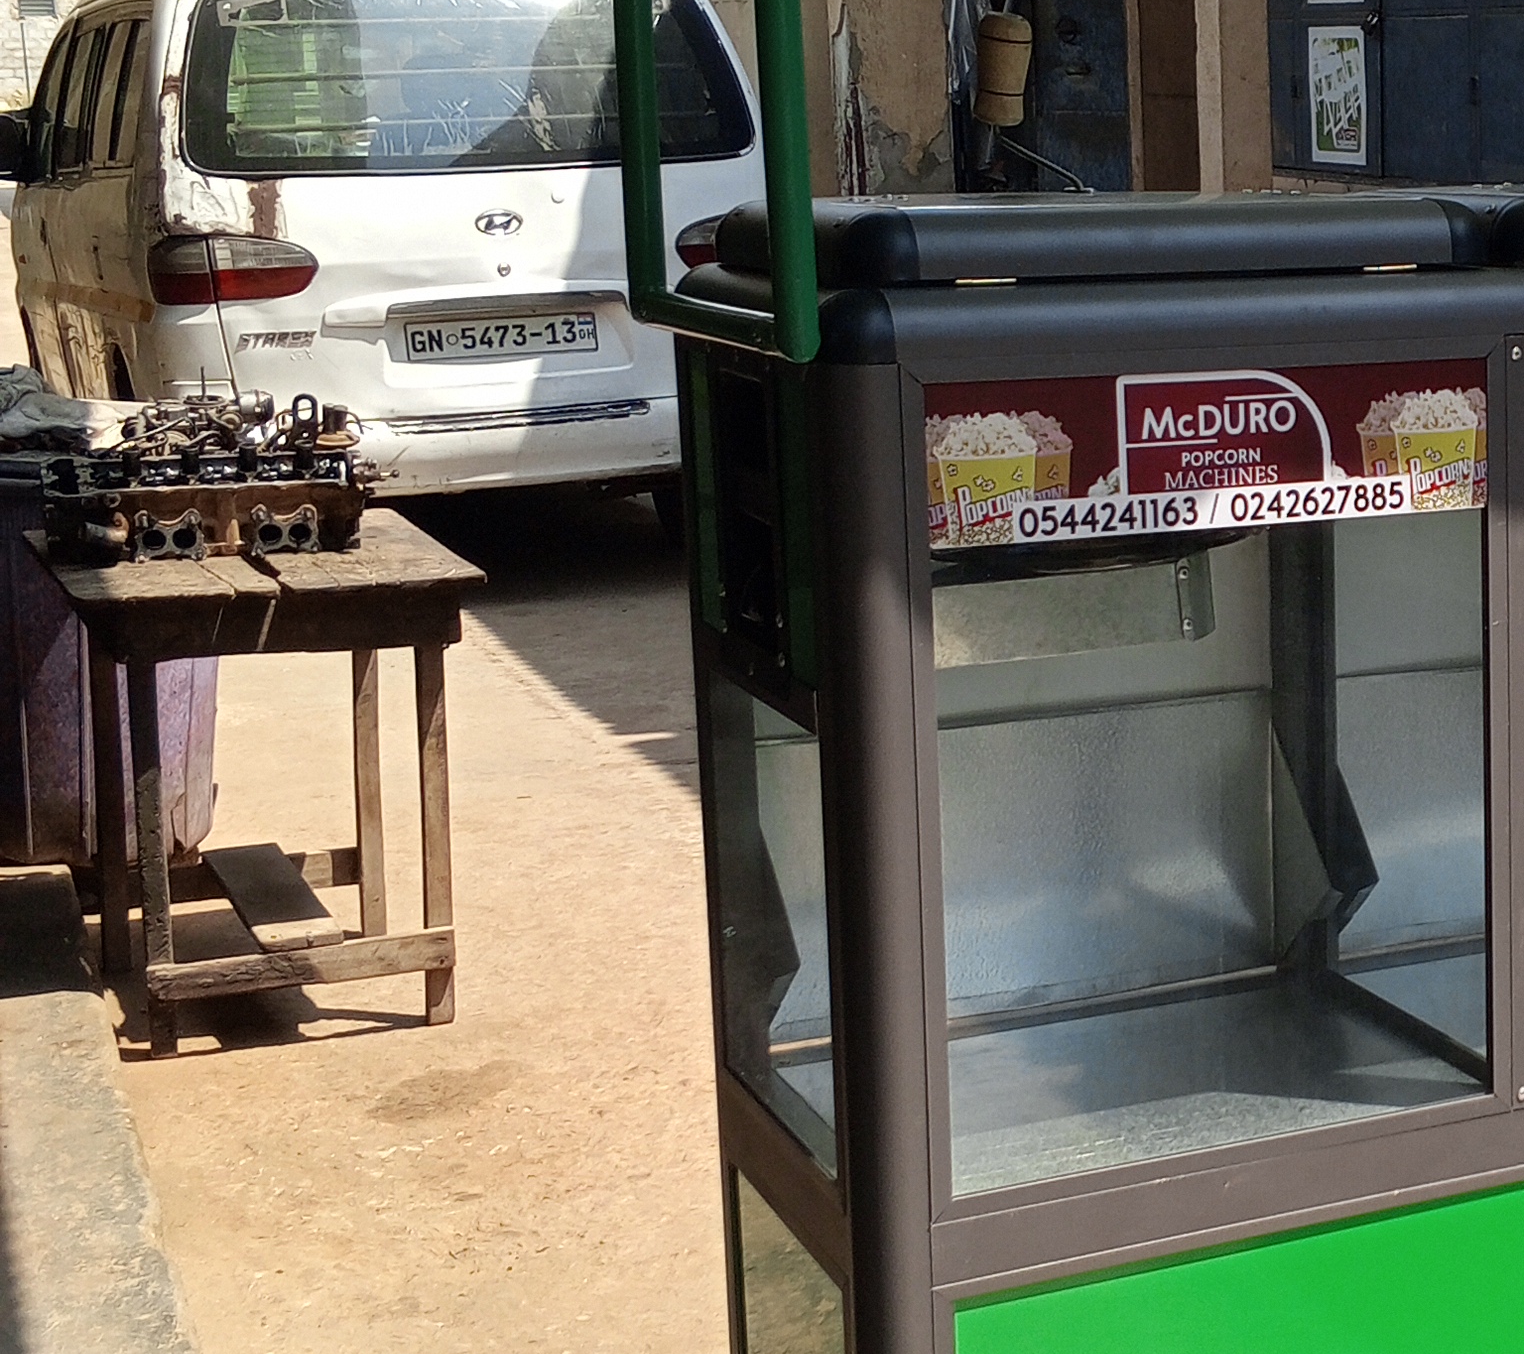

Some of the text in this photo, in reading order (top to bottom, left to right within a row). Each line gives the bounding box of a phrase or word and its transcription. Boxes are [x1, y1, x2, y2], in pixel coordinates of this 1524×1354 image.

[1141, 400, 1297, 440] McDURO
[1181, 448, 1261, 467] POPCORN
[1164, 465, 1279, 491] MACHINES
[1018, 495, 1199, 538] 0544241163
[1230, 482, 1404, 523] 0242627885
